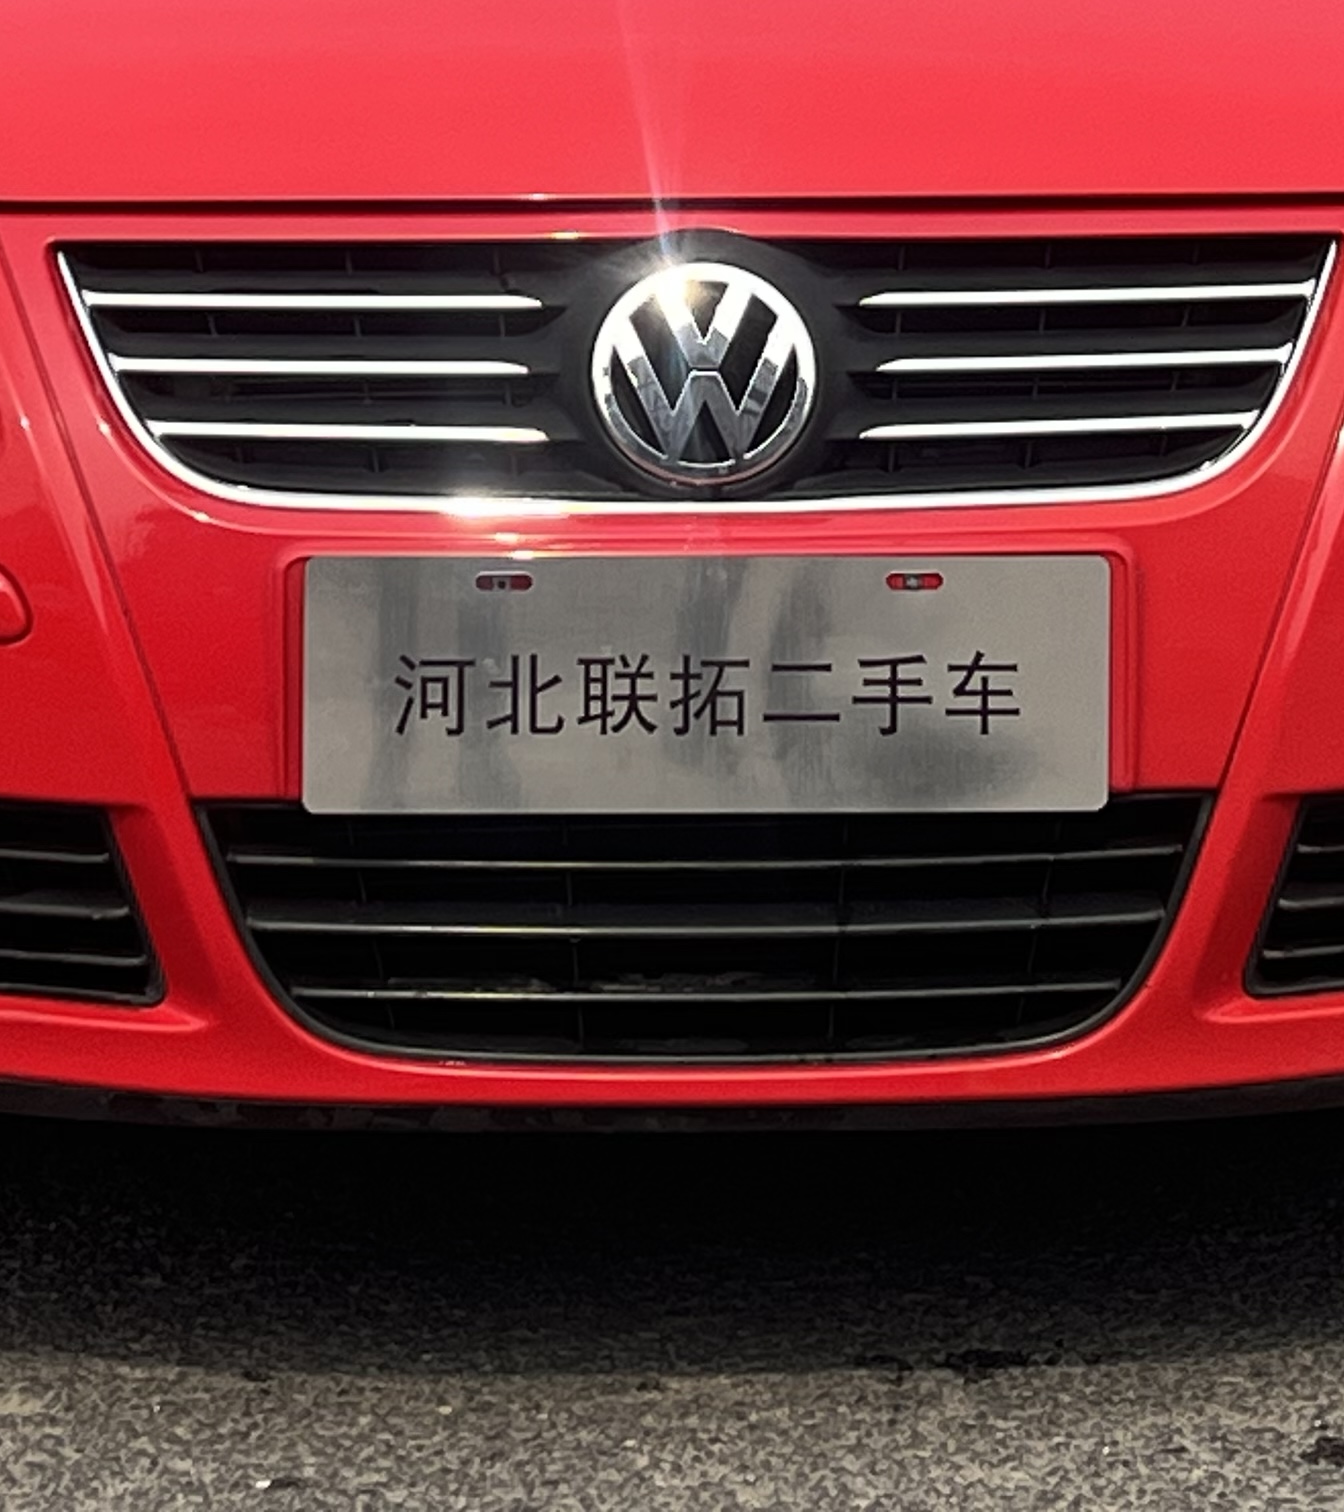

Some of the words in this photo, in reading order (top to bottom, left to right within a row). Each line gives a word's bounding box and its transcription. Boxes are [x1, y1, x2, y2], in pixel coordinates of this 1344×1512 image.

[393, 650, 1022, 738] 河北联拓二手车
